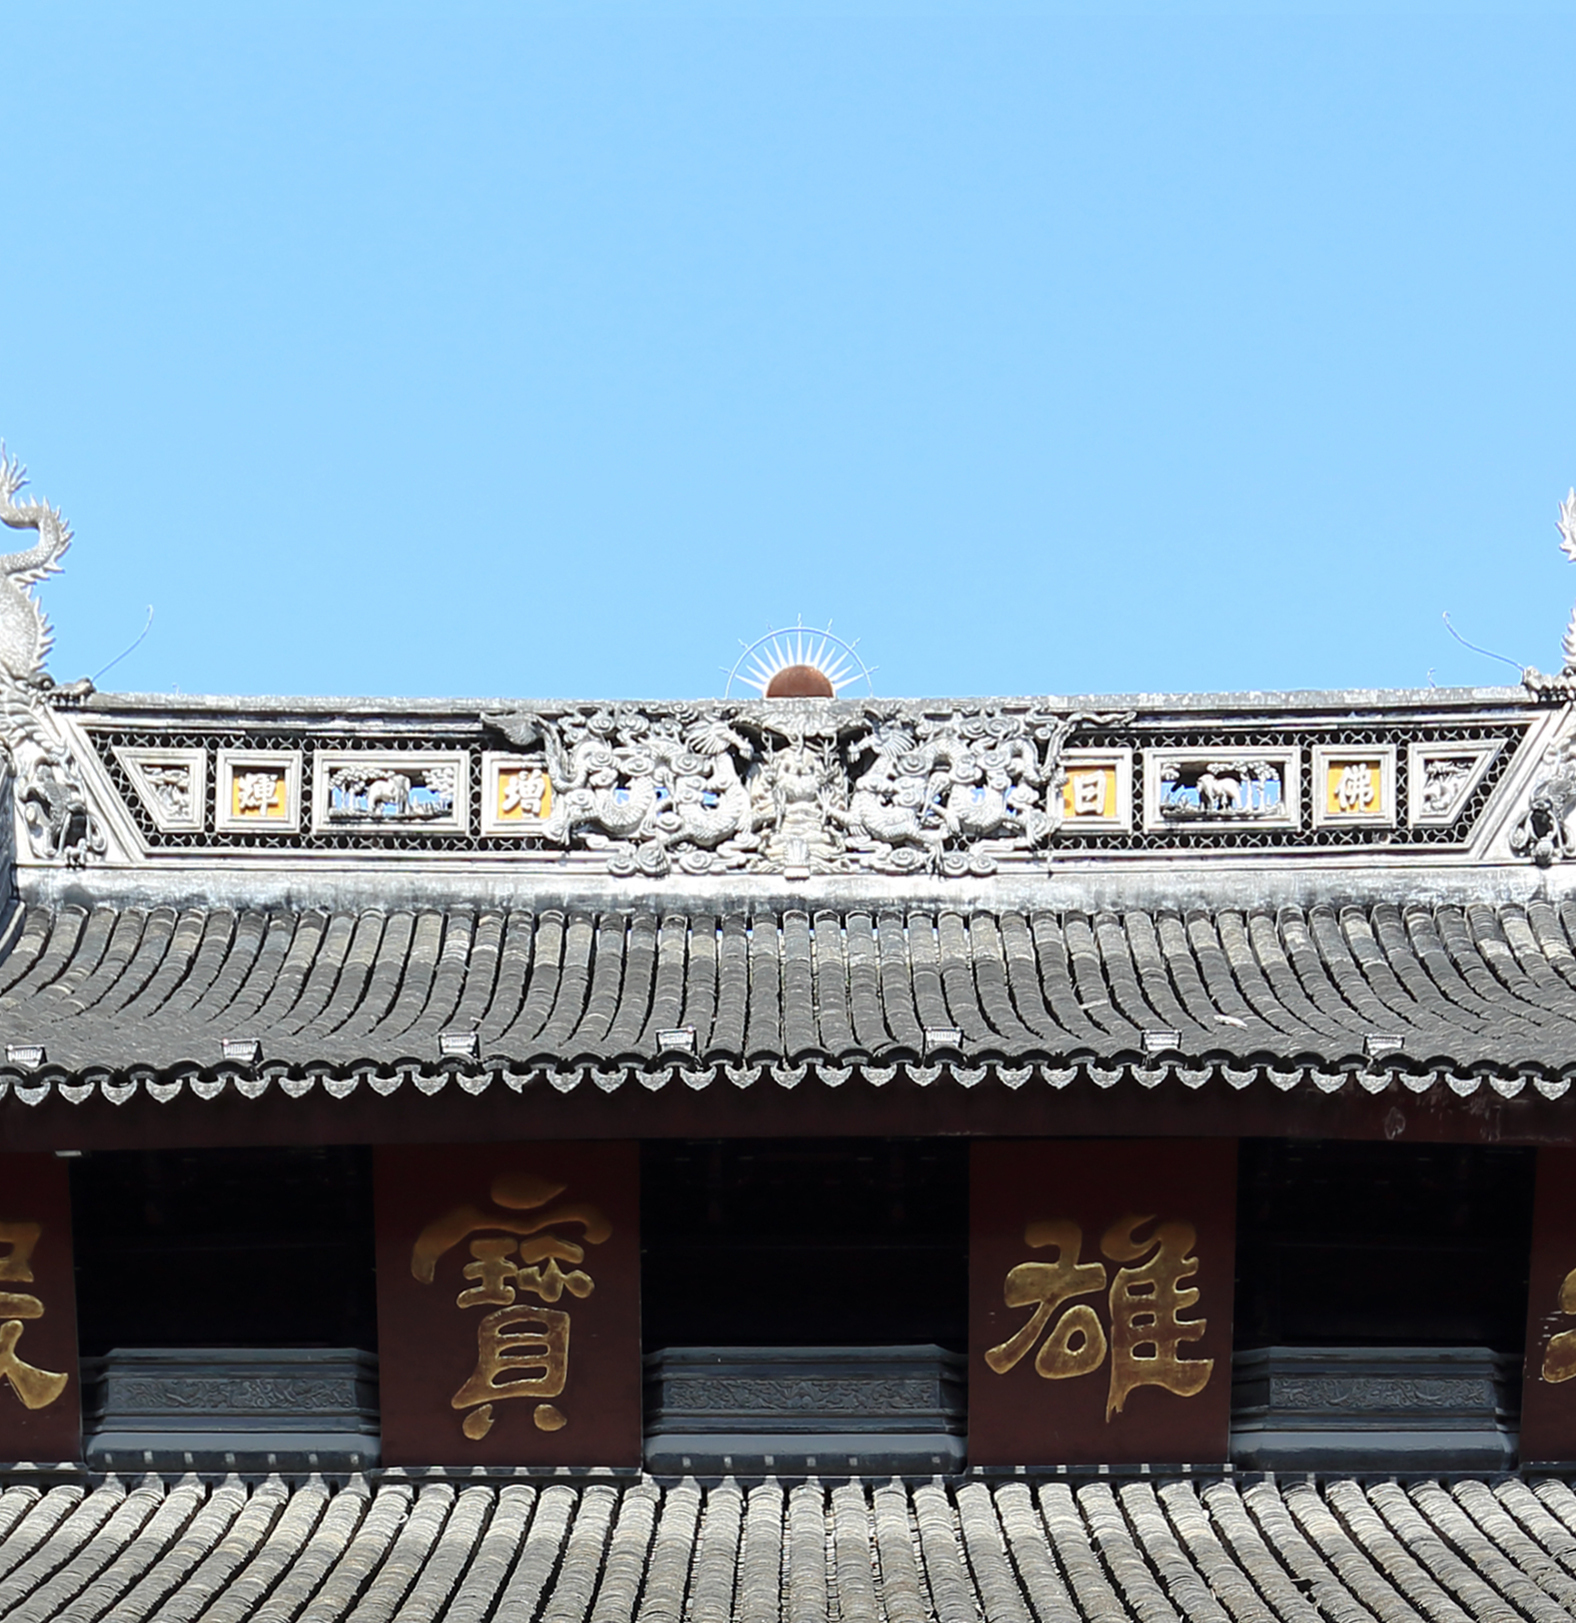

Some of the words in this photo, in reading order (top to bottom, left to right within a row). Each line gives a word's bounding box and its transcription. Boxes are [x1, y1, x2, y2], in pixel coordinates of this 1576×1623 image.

[237, 772, 279, 817] 輝
[502, 766, 544, 817] 增
[1073, 768, 1108, 815] 日
[1334, 762, 1376, 812] 佛
[984, 1214, 1216, 1423] 雄
